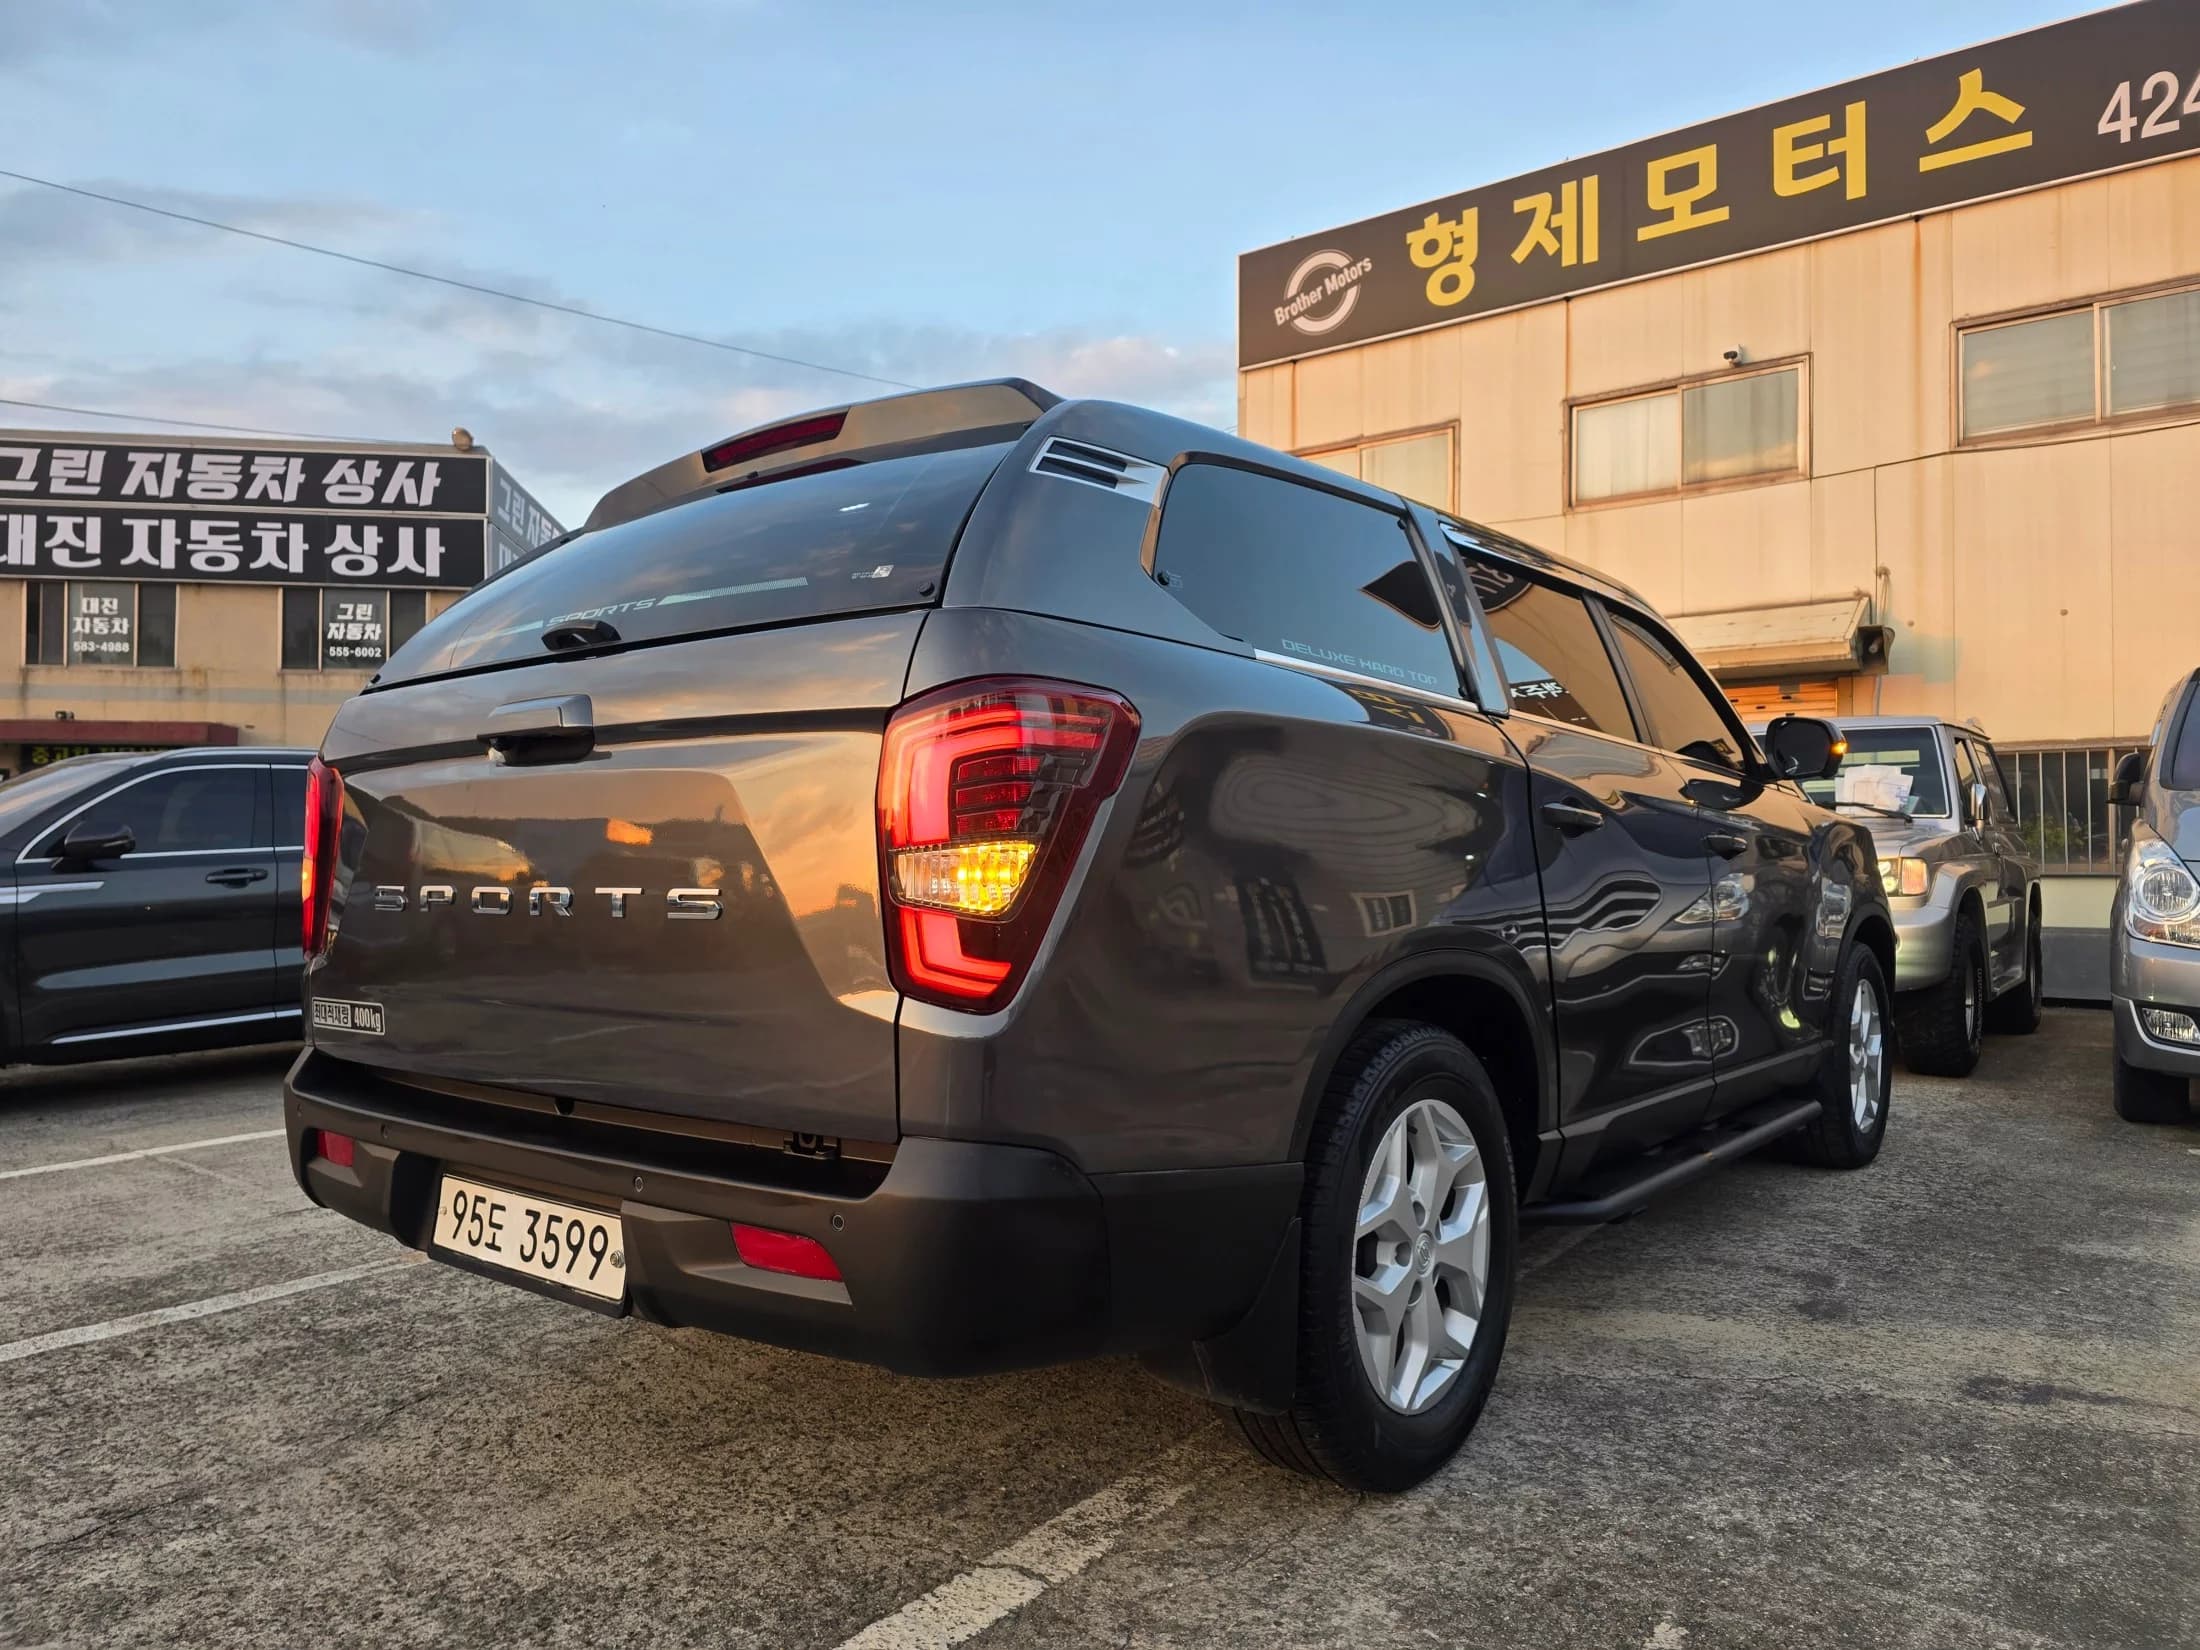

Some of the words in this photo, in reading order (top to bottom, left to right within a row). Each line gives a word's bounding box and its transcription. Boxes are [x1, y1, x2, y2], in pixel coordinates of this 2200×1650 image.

[1406, 68, 2032, 306] 형제모터스
[1274, 285, 1323, 326] Brother
[1323, 257, 1373, 296] Motors
[0, 446, 107, 496] 그린
[120, 451, 306, 503] 자동차
[321, 458, 441, 507] 상사
[497, 477, 526, 537] 그린
[527, 504, 563, 548] 자동
[0, 513, 102, 568] 대진
[120, 517, 309, 573] 자동차
[324, 523, 446, 577] 상사
[72, 616, 129, 635] 자동차
[81, 597, 119, 615] 대진
[337, 603, 373, 621] 그린
[545, 597, 657, 627] SPORTS
[327, 622, 382, 640] 자동차
[1281, 638, 1357, 666] DELUXE
[1359, 658, 1405, 679] HARD
[1407, 670, 1438, 686] TOP
[374, 884, 724, 920] SPORTS
[354, 1006, 381, 1032] 400kg
[452, 1189, 506, 1253] 95도
[519, 1208, 609, 1281] 3599
